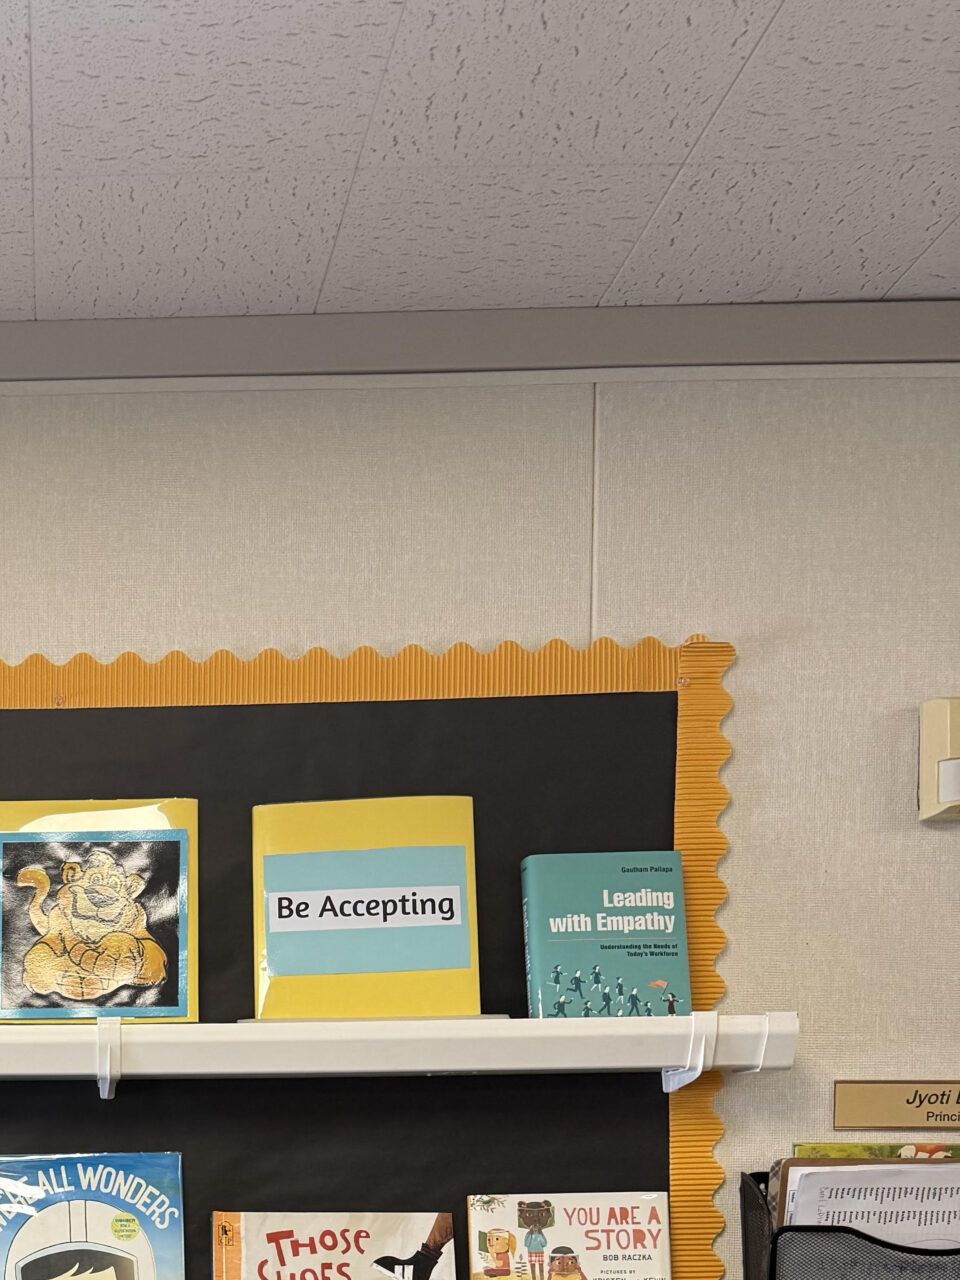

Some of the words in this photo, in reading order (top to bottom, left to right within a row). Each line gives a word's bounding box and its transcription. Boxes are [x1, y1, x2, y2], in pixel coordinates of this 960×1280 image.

[277, 895, 310, 919] Be
[318, 891, 455, 922] Accepting
[602, 888, 675, 909] Leading
[548, 913, 592, 933] with
[596, 911, 676, 933] Empathy
[906, 1089, 952, 1108] Jyoti
[37, 1165, 74, 1195] ALL
[77, 1163, 179, 1230] WONDERS
[563, 1207, 600, 1226] YOU
[607, 1206, 641, 1225] ARE
[647, 1206, 661, 1225] A
[584, 1228, 662, 1251] STORY
